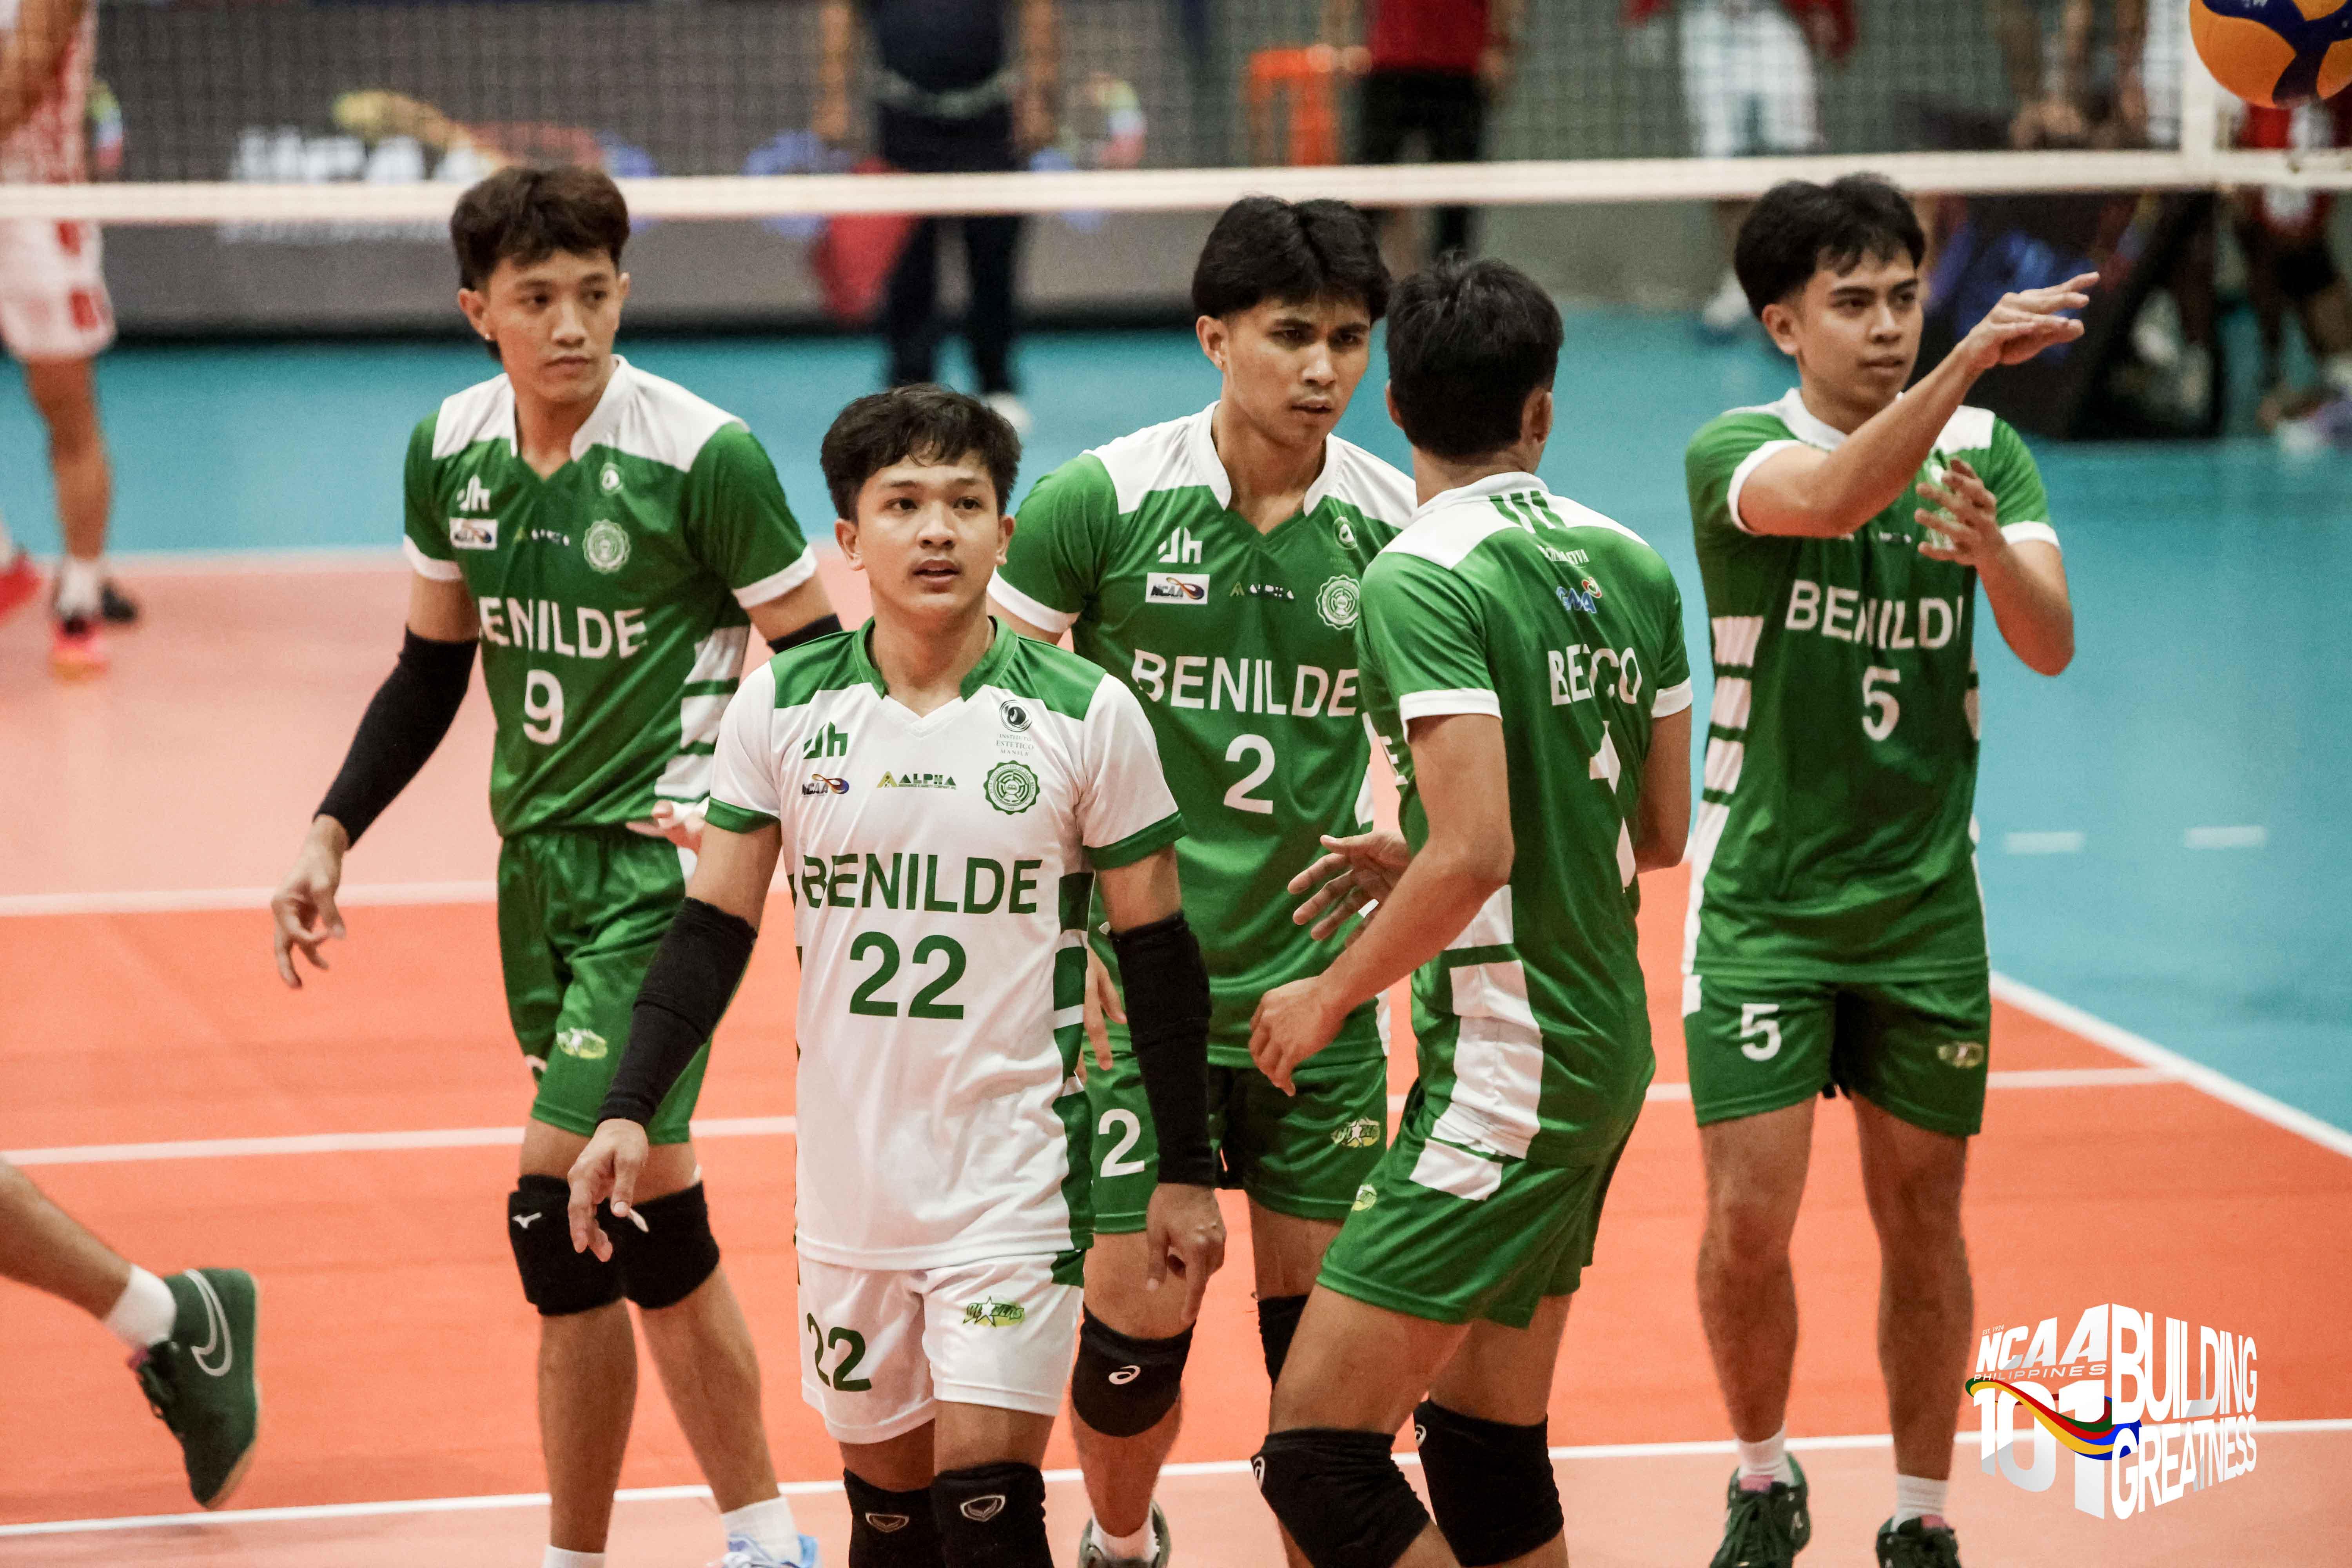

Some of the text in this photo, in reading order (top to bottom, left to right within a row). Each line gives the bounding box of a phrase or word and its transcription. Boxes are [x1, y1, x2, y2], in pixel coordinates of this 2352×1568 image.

[479, 596, 648, 659] ENILDE
[1785, 579, 1963, 650] BENILD
[523, 669, 564, 745] 9
[1131, 649, 1359, 717] BENILDE
[1862, 666, 1900, 741] 5
[996, 740, 1034, 750] ESTETICO
[1223, 734, 1275, 814] 2
[899, 773, 956, 786] ALPHA
[802, 853, 1043, 914] BENILDE
[849, 931, 967, 1020] 22
[1741, 1004, 1781, 1061] 5
[1098, 1109, 1145, 1177] 2
